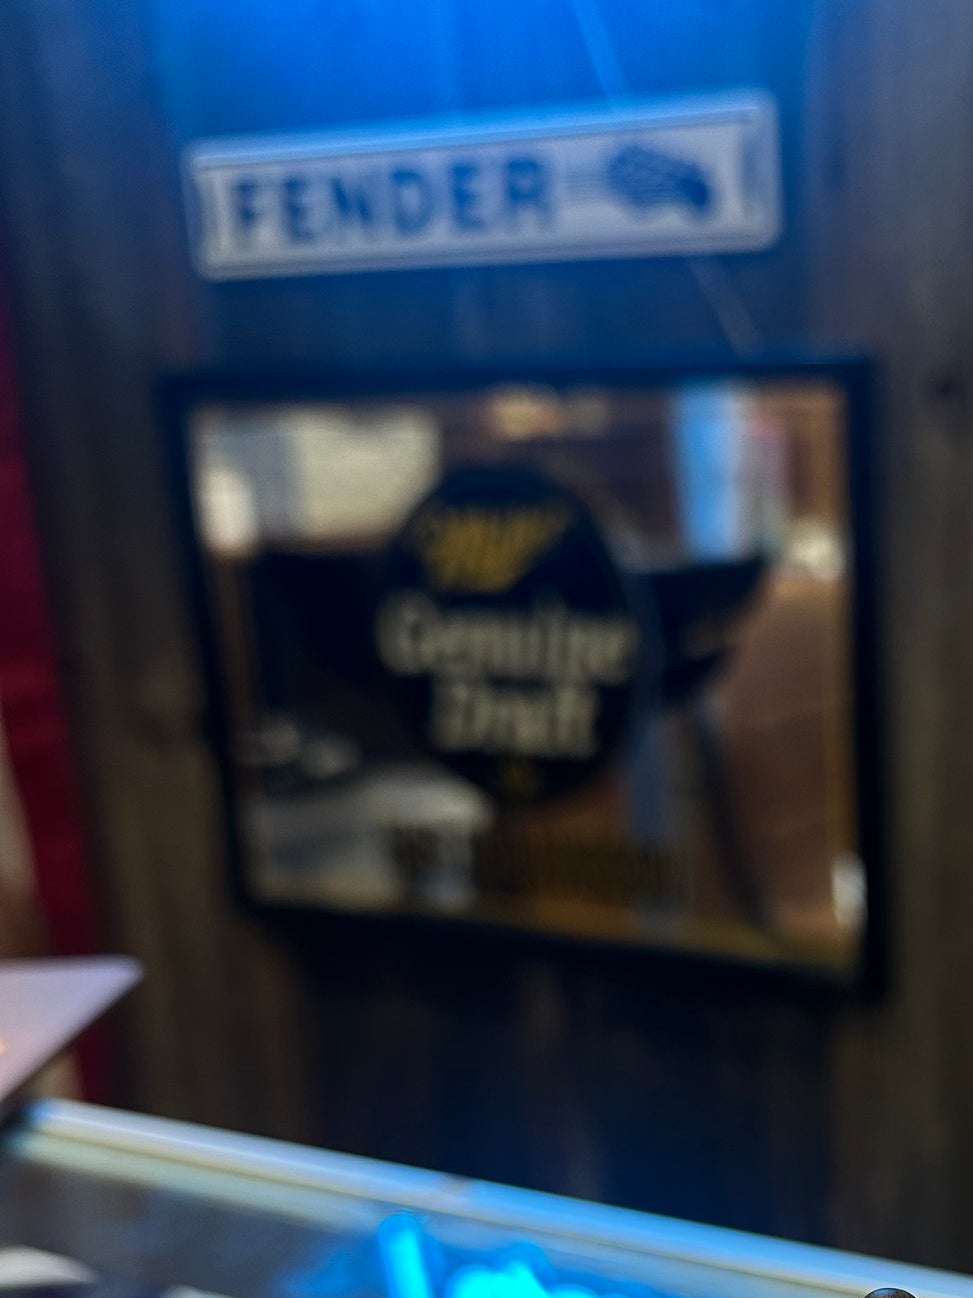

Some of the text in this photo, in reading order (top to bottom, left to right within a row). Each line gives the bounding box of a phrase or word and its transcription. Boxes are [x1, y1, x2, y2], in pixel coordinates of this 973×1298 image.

[232, 153, 558, 252] FENDER
[377, 592, 638, 686] Genuine
[432, 684, 600, 758] Draft
